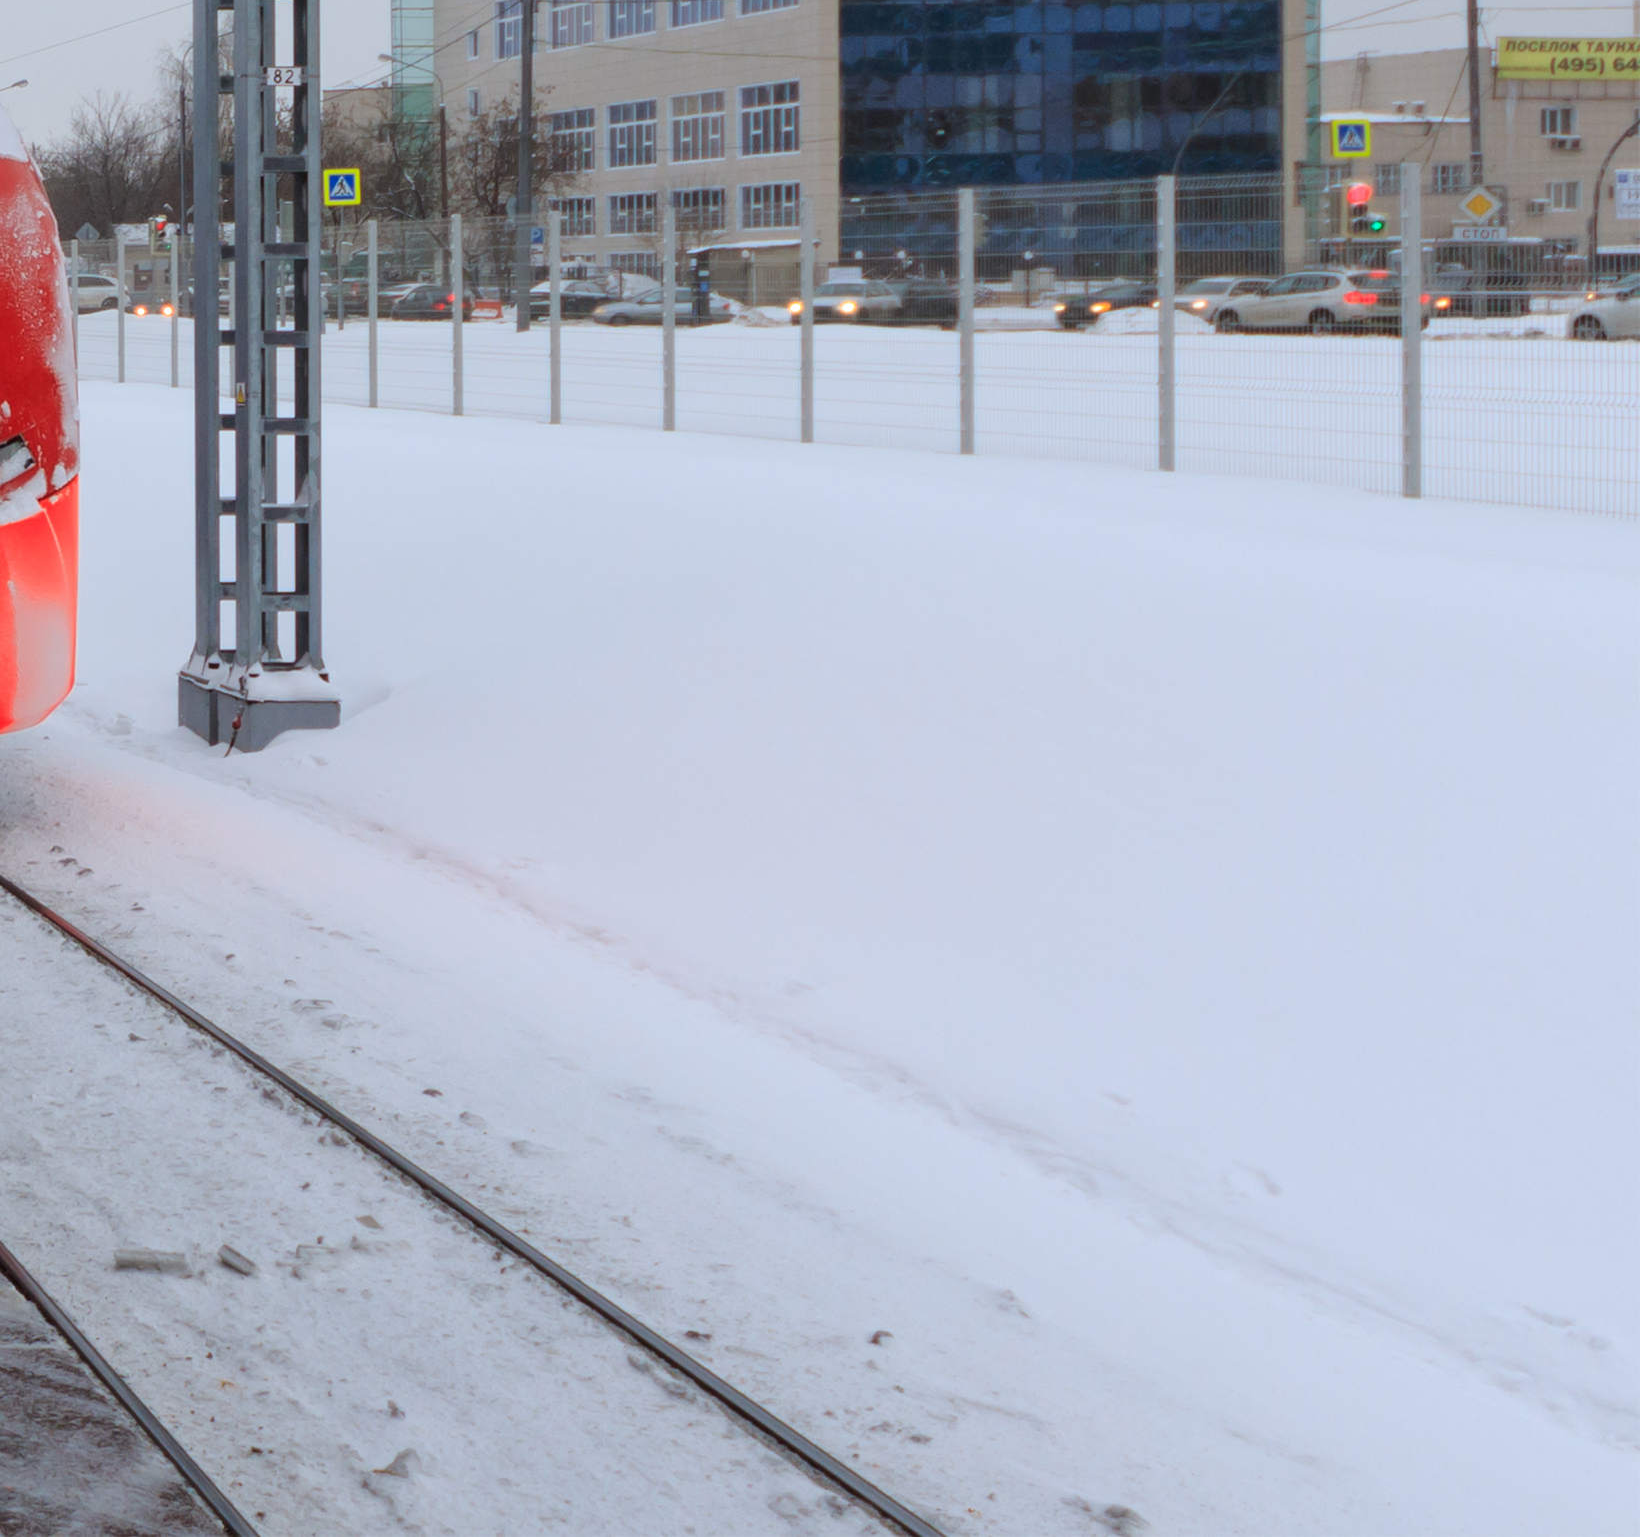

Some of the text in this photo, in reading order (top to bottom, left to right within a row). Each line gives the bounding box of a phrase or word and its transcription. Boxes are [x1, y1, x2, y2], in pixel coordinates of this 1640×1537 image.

[1505, 40, 1581, 53] ПОСЕЛОК
[1550, 57, 1605, 75] (495)
[273, 68, 295, 84] 82
[1462, 229, 1500, 239] СТОП
